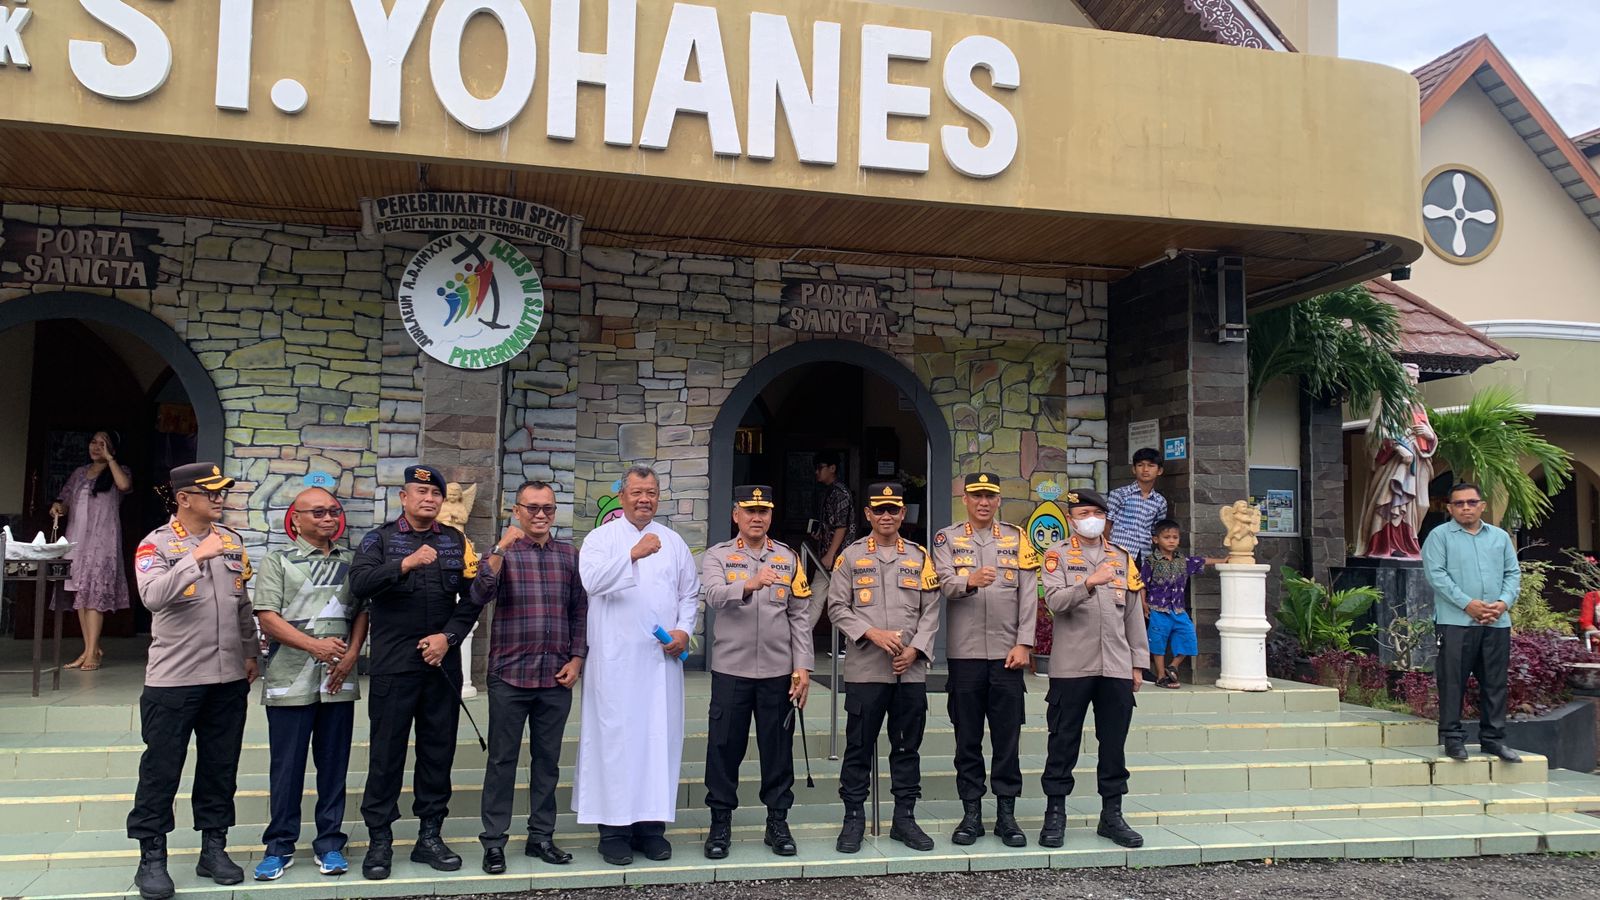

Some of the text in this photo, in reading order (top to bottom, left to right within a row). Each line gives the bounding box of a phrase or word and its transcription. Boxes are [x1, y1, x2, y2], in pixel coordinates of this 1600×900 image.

[68, 0, 1020, 179] ST. YOHANES
[377, 193, 568, 232] PEREGRINANTES IN SPEM
[36, 227, 134, 257] PORTA
[23, 254, 147, 287] SANCTA
[448, 238, 543, 368] PEREGRINANTES IN SPEM
[801, 282, 878, 309] PORTA
[400, 295, 434, 348] JUBILAEUM
[789, 307, 888, 336] SANCTA
[899, 567, 921, 576] POLRI
